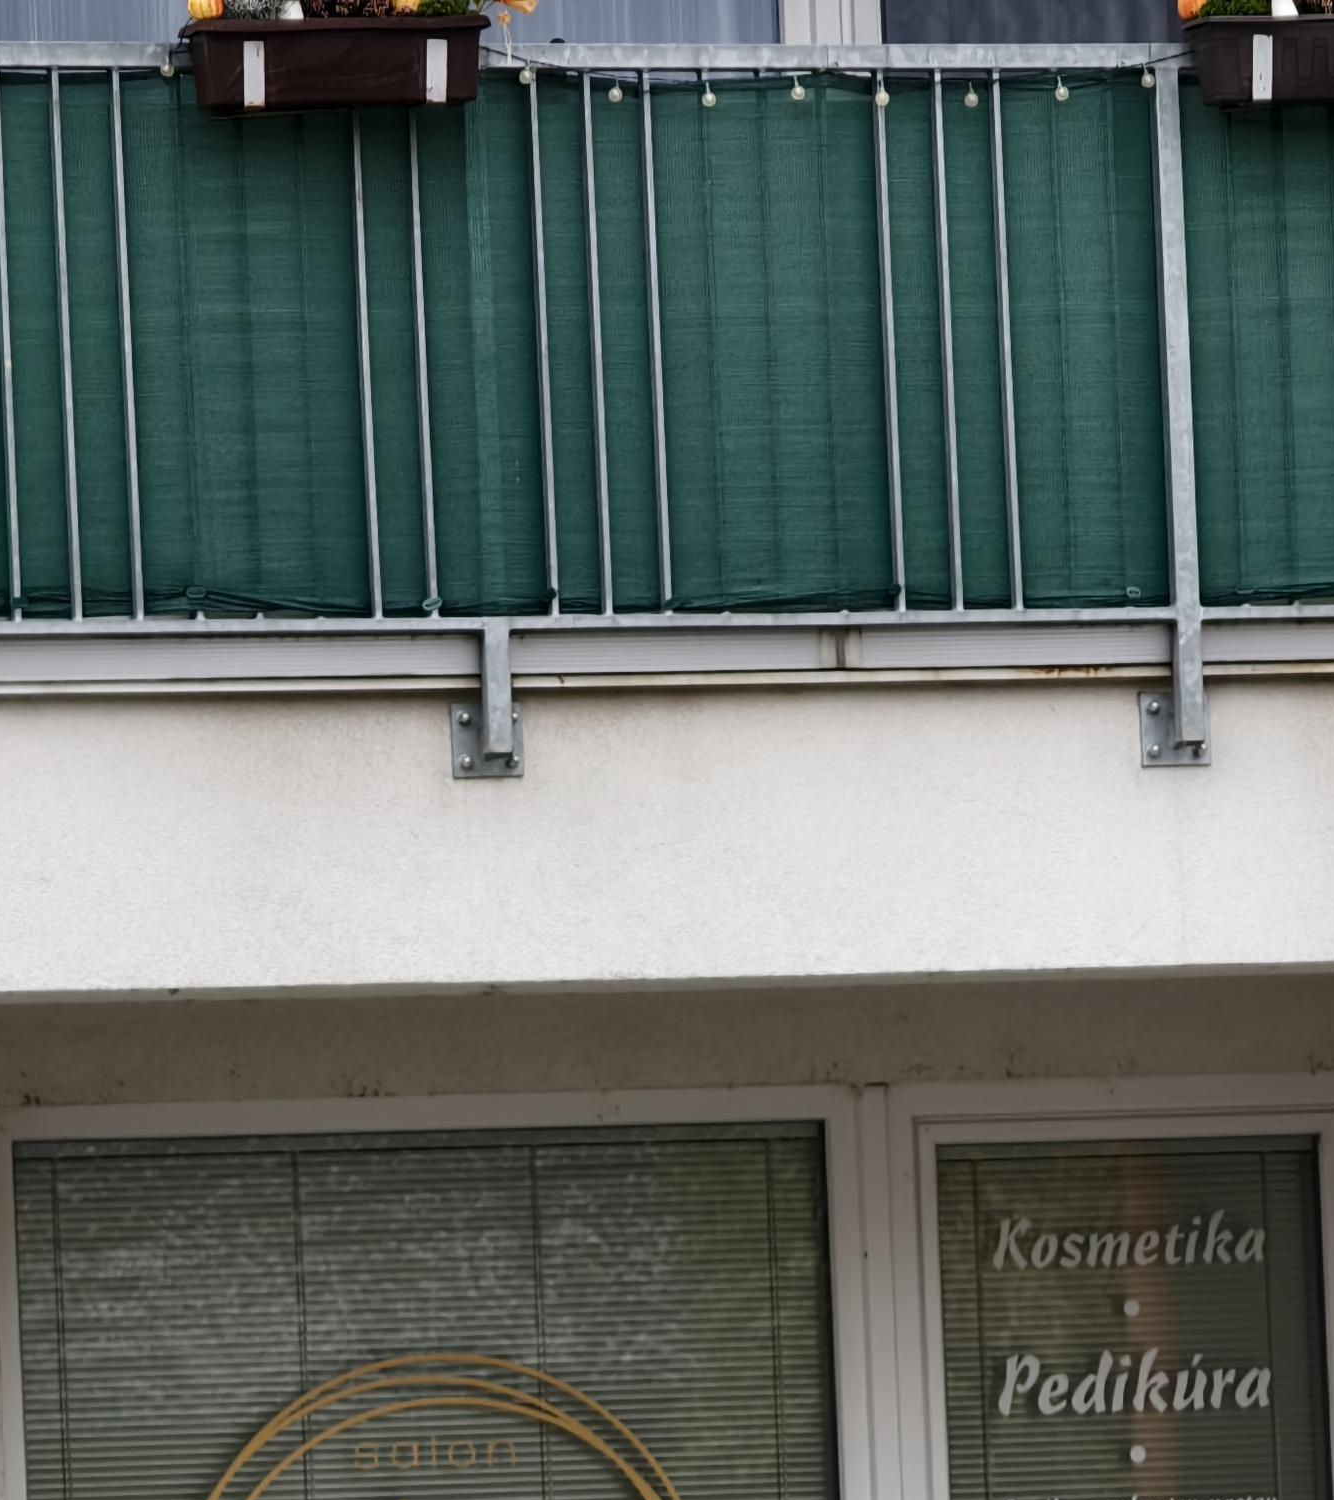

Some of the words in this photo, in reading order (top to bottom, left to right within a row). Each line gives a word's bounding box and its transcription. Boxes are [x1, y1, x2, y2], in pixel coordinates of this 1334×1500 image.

[993, 1210, 1265, 1270] Kosmetika
[998, 1348, 1271, 1416] Pedikúra
[354, 1434, 518, 1470] salon
